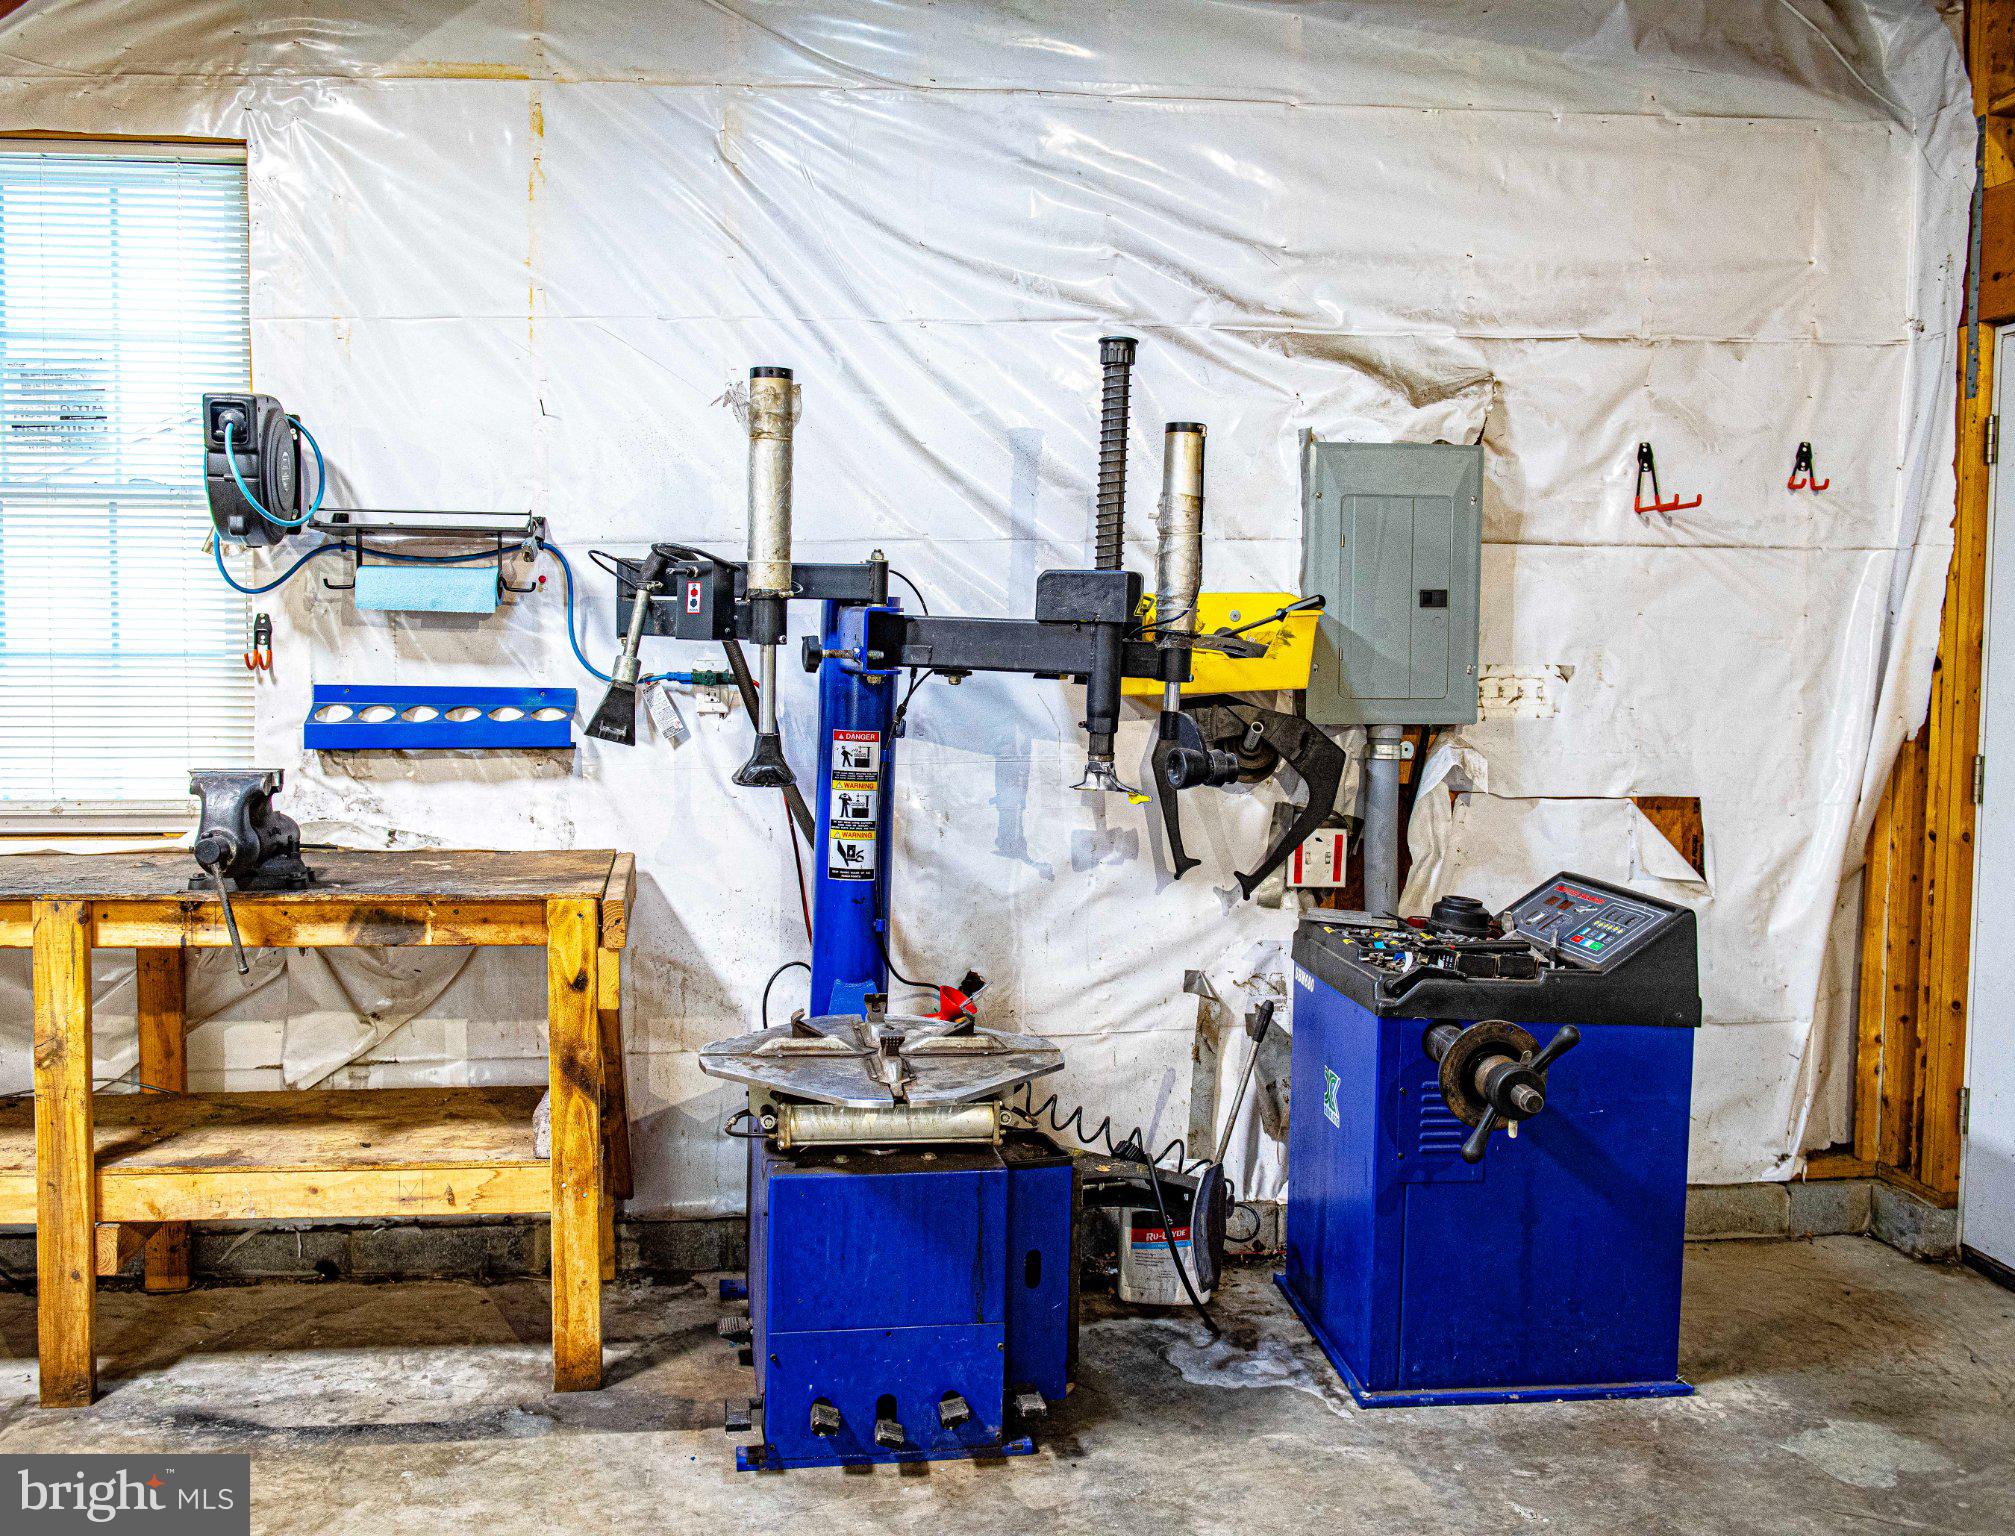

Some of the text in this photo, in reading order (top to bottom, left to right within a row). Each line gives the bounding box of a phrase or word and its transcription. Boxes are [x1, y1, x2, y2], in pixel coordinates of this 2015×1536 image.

[845, 733, 876, 741] DANGER
[843, 782, 874, 790] WARNING
[841, 831, 873, 839] WARNING
